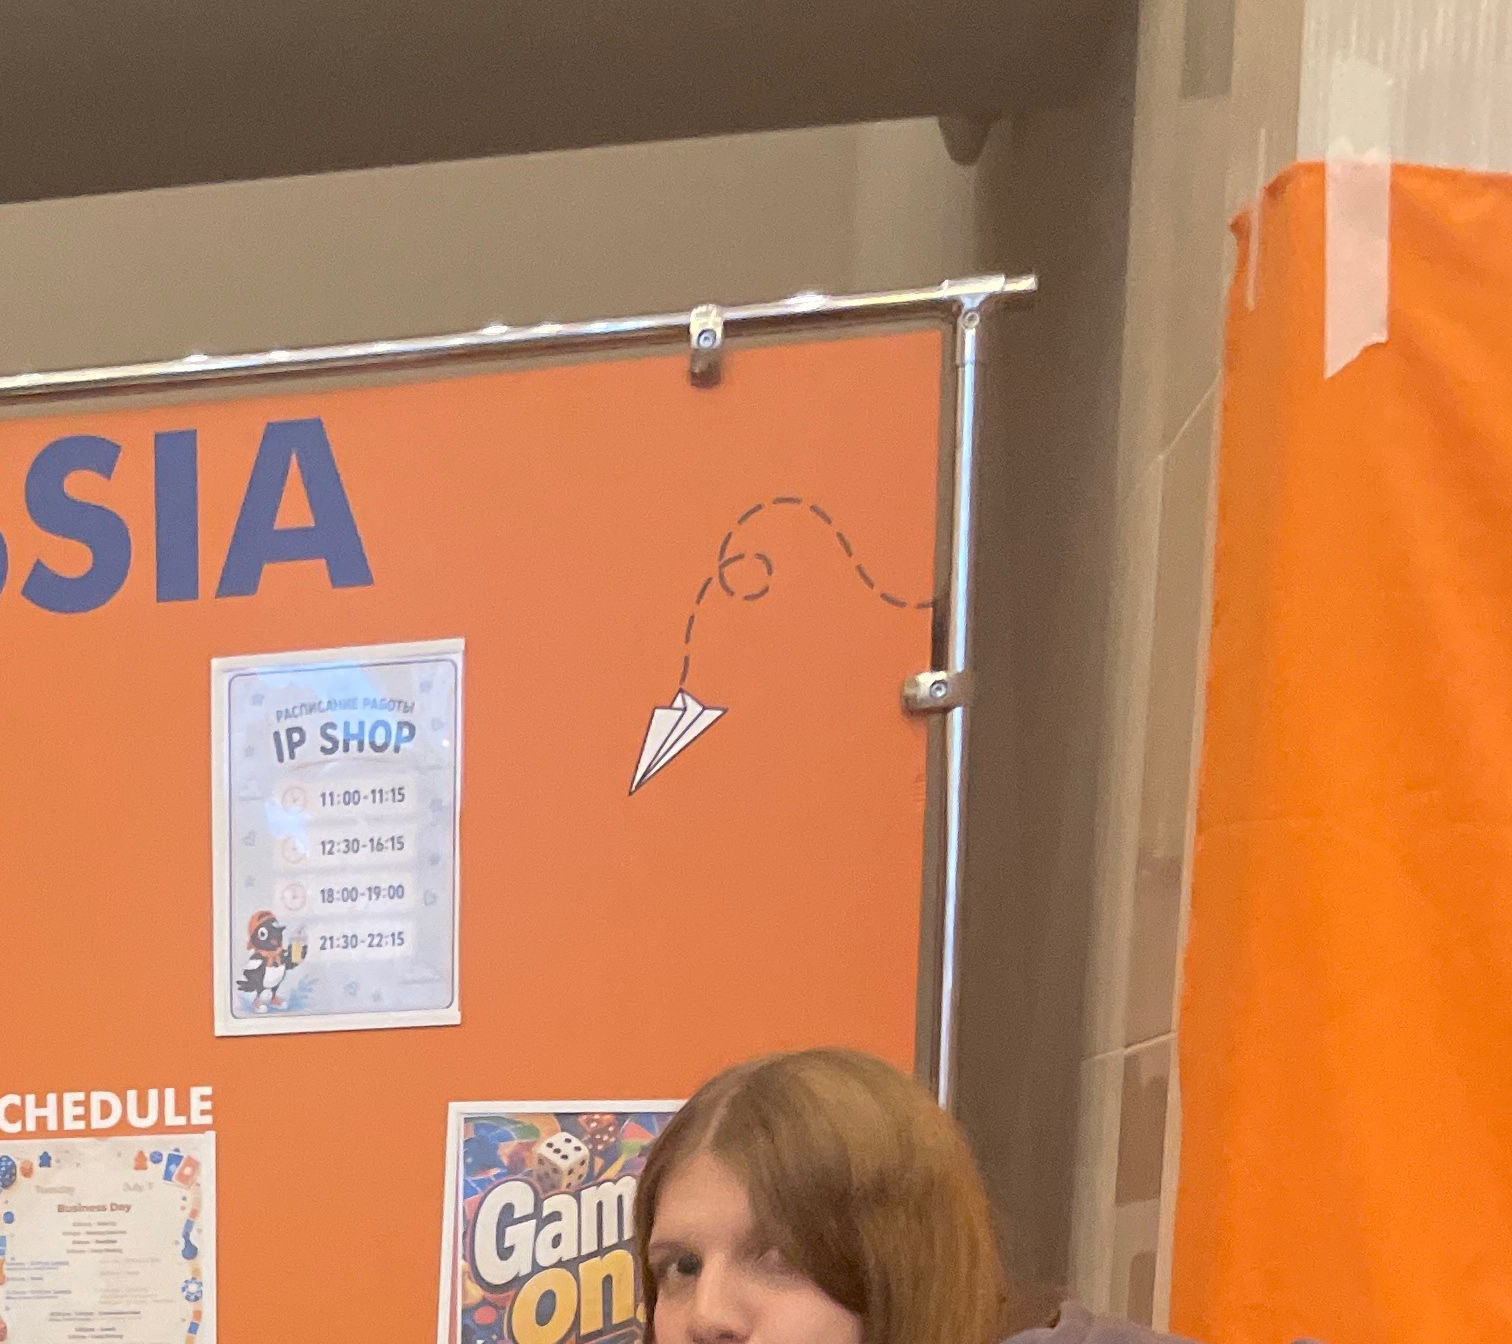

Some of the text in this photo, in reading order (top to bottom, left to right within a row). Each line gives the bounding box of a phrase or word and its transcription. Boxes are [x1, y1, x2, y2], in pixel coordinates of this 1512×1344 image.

[276, 696, 415, 721] РАСПИСАНИЕ РАБОТЫ
[273, 719, 416, 763] IP SHOP
[320, 786, 405, 807] 11:00-11:15
[320, 836, 405, 855] 12:30-16:15
[320, 884, 405, 904] 18:00-19:00
[319, 931, 405, 951] 21:30-22:15
[57, 1202, 132, 1214] Business Day
[474, 1175, 636, 1285] Gam
